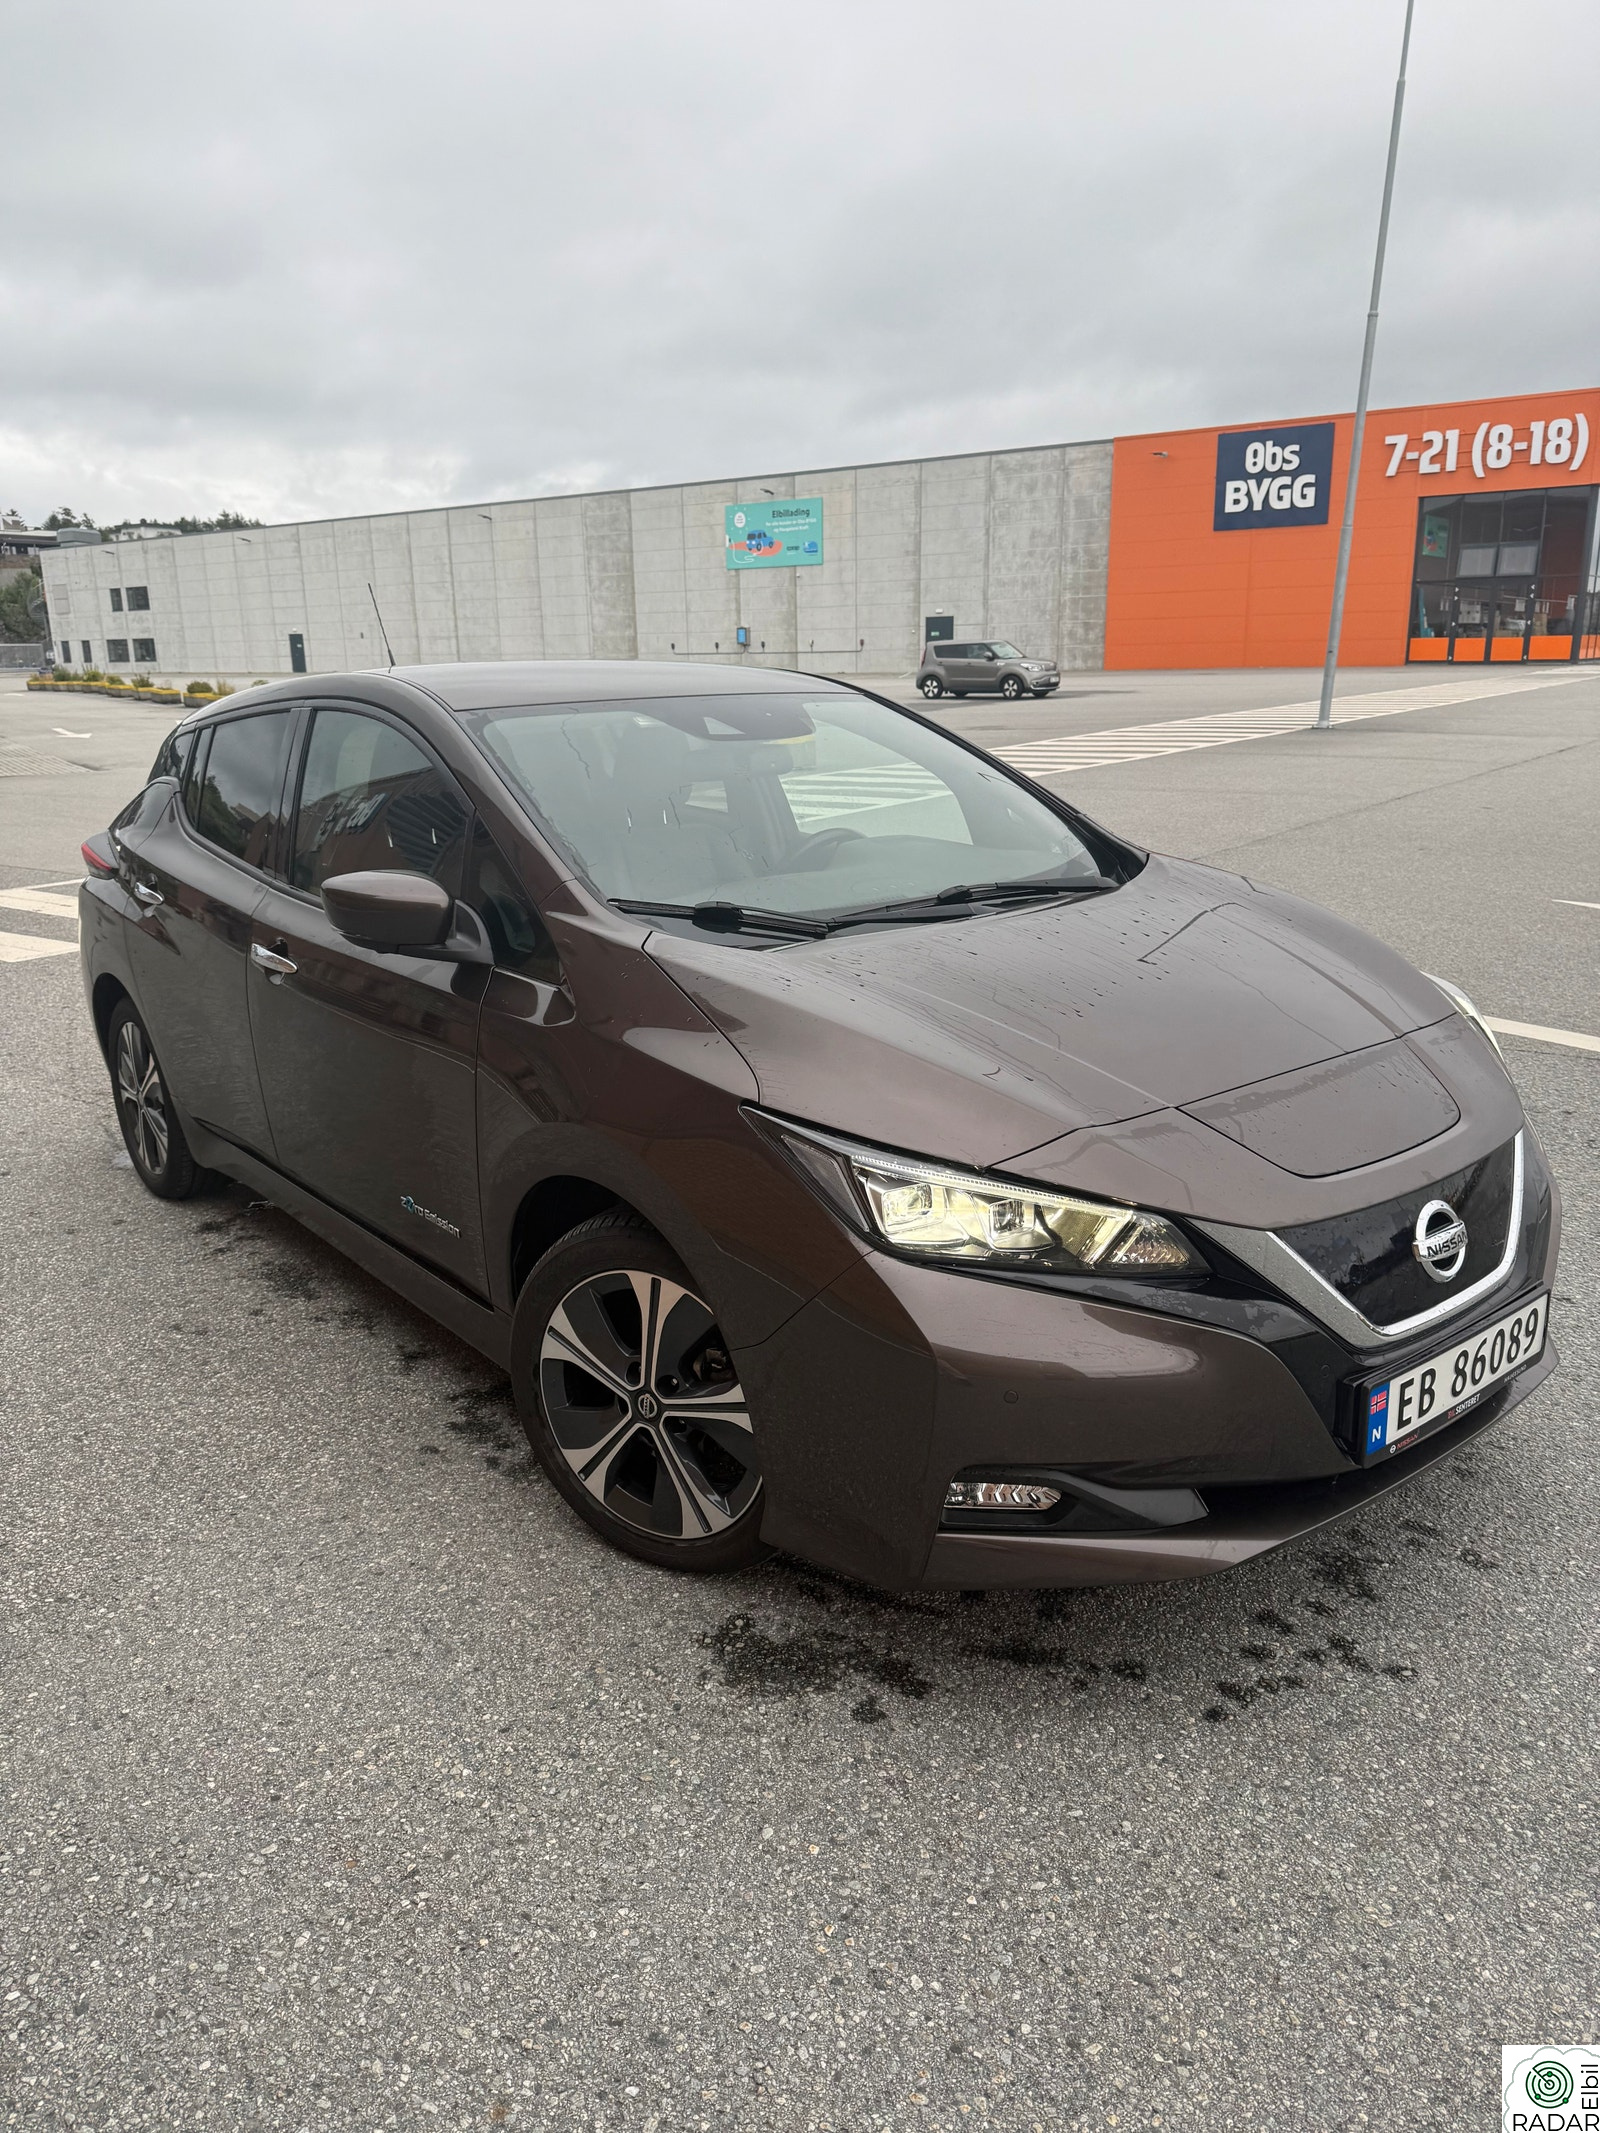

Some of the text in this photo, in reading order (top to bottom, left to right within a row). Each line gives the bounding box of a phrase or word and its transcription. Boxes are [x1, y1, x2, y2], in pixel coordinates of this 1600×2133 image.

[1384, 413, 1590, 478] 7-21 (8-18)
[1224, 474, 1317, 514] BYGG
[771, 508, 811, 519] Elbillading
[1427, 1230, 1467, 1258] NISSAN
[1397, 1307, 1539, 1431] EB 86089
[1371, 1425, 1382, 1442] N
